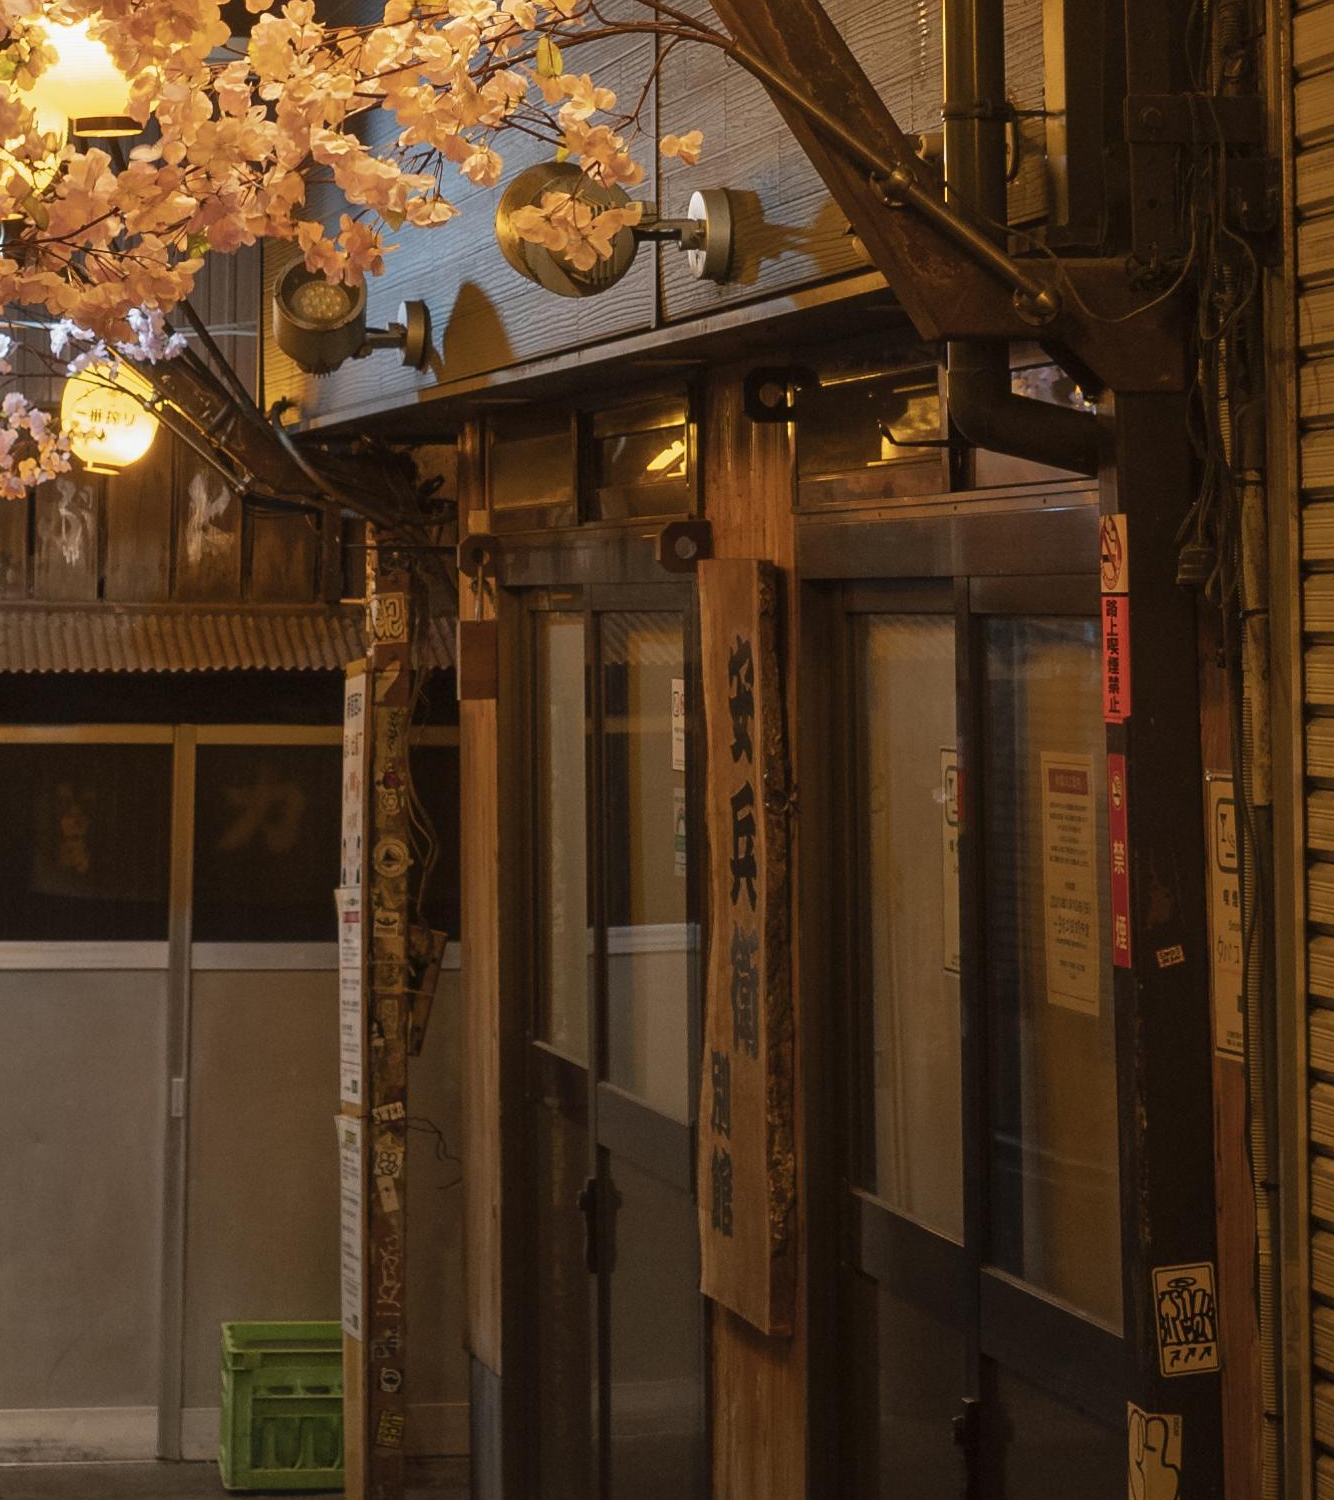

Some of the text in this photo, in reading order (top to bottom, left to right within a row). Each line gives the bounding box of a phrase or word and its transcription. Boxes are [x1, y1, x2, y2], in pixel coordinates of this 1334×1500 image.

[1105, 599, 1122, 713] 路上喫煙禁止
